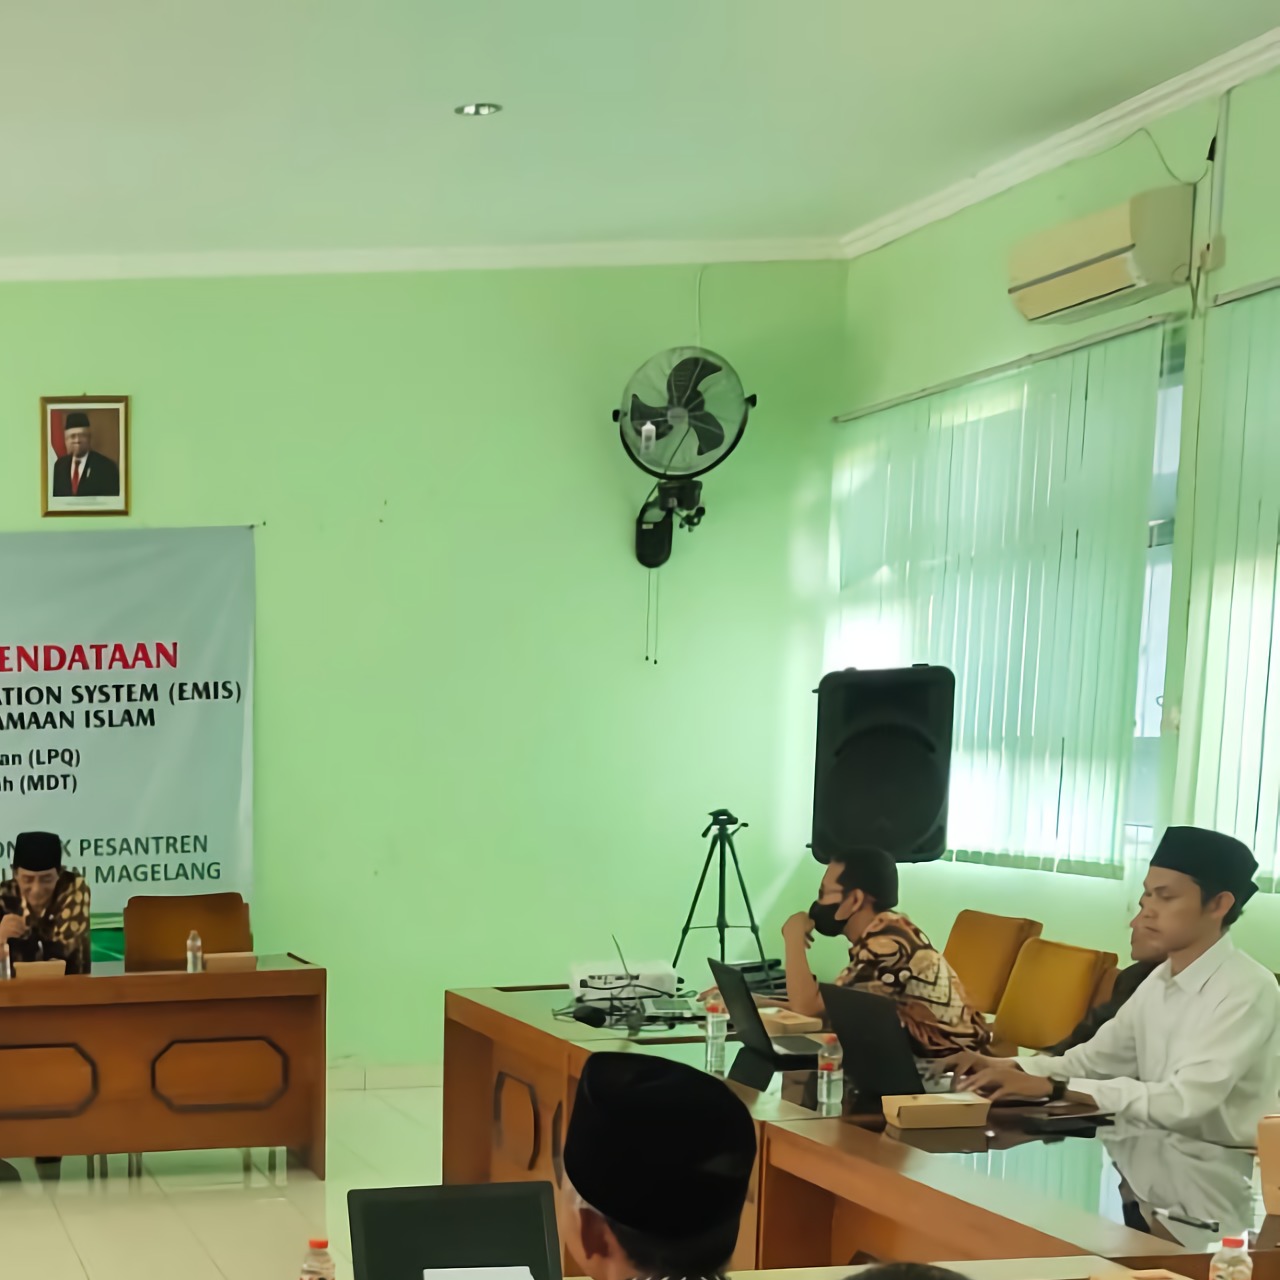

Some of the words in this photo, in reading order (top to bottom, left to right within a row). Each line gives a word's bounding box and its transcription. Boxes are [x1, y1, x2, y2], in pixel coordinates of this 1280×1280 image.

[71, 683, 159, 705] SYSTEM
[169, 680, 242, 706] (EMIS)
[85, 708, 156, 729] ISLAM
[29, 748, 81, 769] (LPQ)
[20, 774, 77, 795] (MDT)
[80, 835, 208, 857] PESANTREN
[95, 861, 221, 885] MAGELANG
